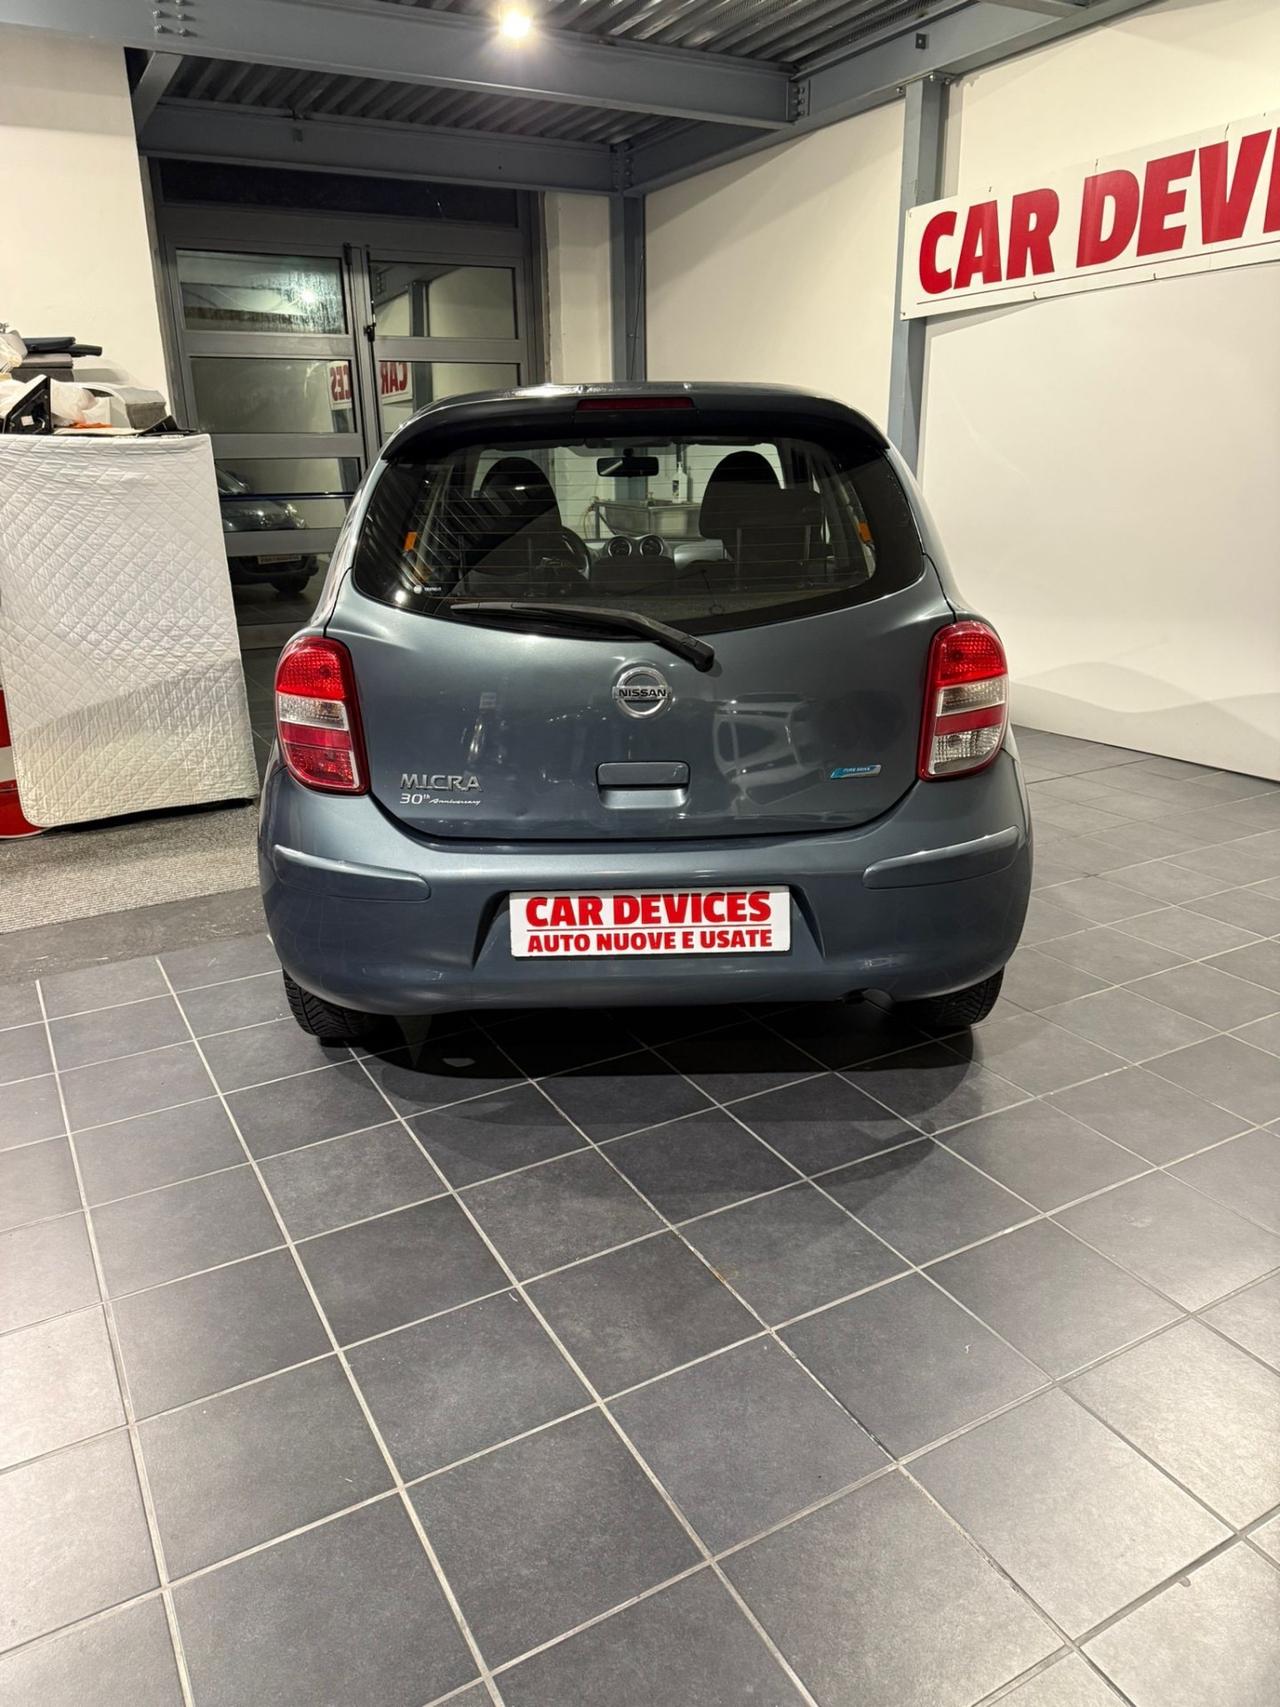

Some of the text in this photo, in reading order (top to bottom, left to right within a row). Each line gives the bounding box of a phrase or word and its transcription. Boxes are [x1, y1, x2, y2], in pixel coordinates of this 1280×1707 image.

[919, 188, 1059, 295] CAR
[618, 688, 667, 698] NISSAN
[400, 773, 482, 791] MICRA
[526, 891, 772, 927] CAR DEVICES
[527, 929, 772, 952] AUTO NUOVE E USATE
